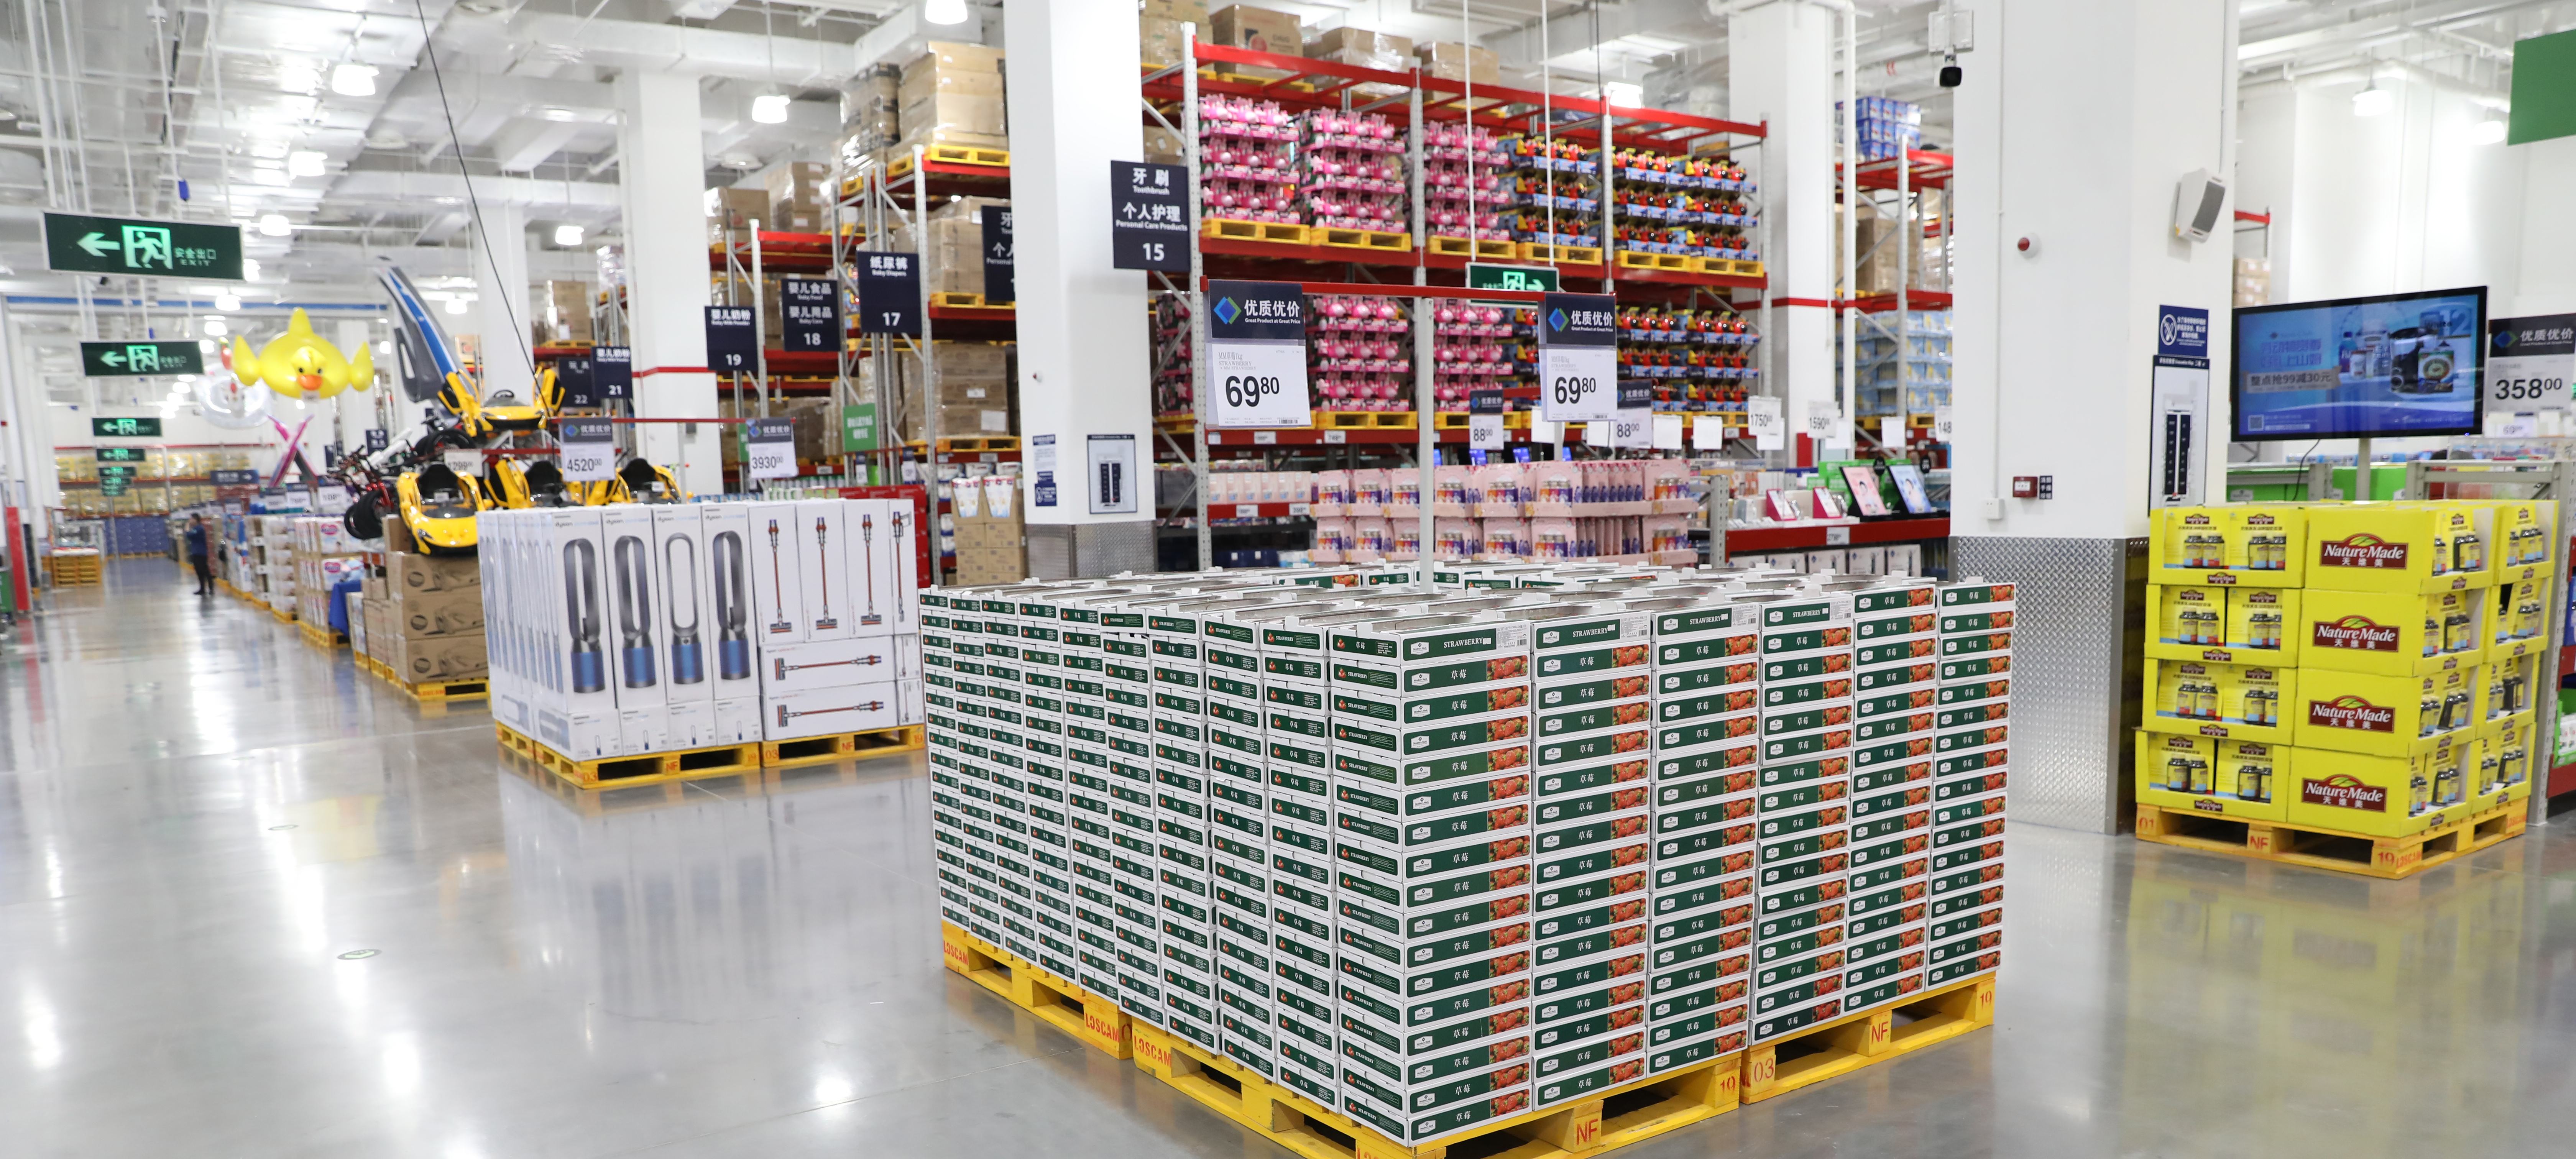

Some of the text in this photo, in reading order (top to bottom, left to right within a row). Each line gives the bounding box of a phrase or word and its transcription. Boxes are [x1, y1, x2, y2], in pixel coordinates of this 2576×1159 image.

[1133, 185, 1170, 195] Toothbrush
[1122, 202, 1180, 222] 个人护理
[1116, 220, 1188, 231] Personal Care Products
[1142, 243, 1164, 261] 15
[1244, 299, 1300, 318] 优质优价
[882, 312, 901, 326] 17
[1571, 310, 1613, 327] 优质优价
[803, 333, 821, 345] 18
[2520, 327, 2574, 342] 优质优价
[725, 353, 742, 366] 19
[608, 384, 622, 395] 21
[574, 394, 589, 404] 22
[2324, 544, 2404, 559] Nature Made
[2341, 557, 2383, 567] 天维美
[1792, 609, 1821, 618] STRAWBERRY
[1689, 615, 1721, 625] STRAWBERRY
[1572, 627, 1608, 637] STRAWBERRY
[2317, 625, 2396, 642] Nature Made
[1444, 637, 1483, 648] STRAWBERRY
[1796, 636, 1808, 646] 草莓
[2334, 639, 2376, 649] 天维美
[1696, 645, 1709, 656] 草莓
[1579, 656, 1594, 667] 草莓
[1347, 671, 1368, 679] STRAWBERRY
[1450, 668, 1467, 680] 草莓
[2313, 704, 2392, 723] Nature Made
[2330, 718, 2371, 729] 天维美
[1348, 731, 1368, 740] STRAWBERRY
[843, 741, 853, 752] NF
[1451, 760, 1468, 773] 草莓
[1579, 773, 1594, 784] 草莓
[1695, 784, 1709, 795] 草莓
[2305, 782, 2383, 802] Nature Made
[1350, 793, 1370, 803] STRAWBERRY
[2323, 796, 2364, 809] 天维美
[1792, 818, 1804, 828] 草莓
[2250, 836, 2269, 850] NF
[1350, 852, 1370, 862] STRAWBERRY
[1453, 852, 1469, 864] 草莓
[1577, 887, 1592, 898] 草莓
[1691, 919, 1704, 930] 草莓
[1353, 937, 1373, 949] STRAWBERRY
[1454, 940, 1470, 952] 草莓
[943, 940, 968, 965] LOSCAM
[1789, 990, 1800, 1000] 草莓
[1577, 998, 1591, 1010] 草莓
[1085, 1013, 1120, 1043] LOSCAM
[1354, 1024, 1373, 1036] STRAWBERRY
[1454, 1026, 1469, 1039] 草莓
[1871, 1020, 1889, 1044] NF
[1134, 1035, 1172, 1067] LOSCAM
[1686, 1047, 1699, 1059] 草莓
[1754, 1057, 1774, 1082] 03
[1357, 1107, 1377, 1121] STRAWBERRY
[1456, 1110, 1471, 1122] 草莓
[1576, 1118, 1598, 1144] NF
